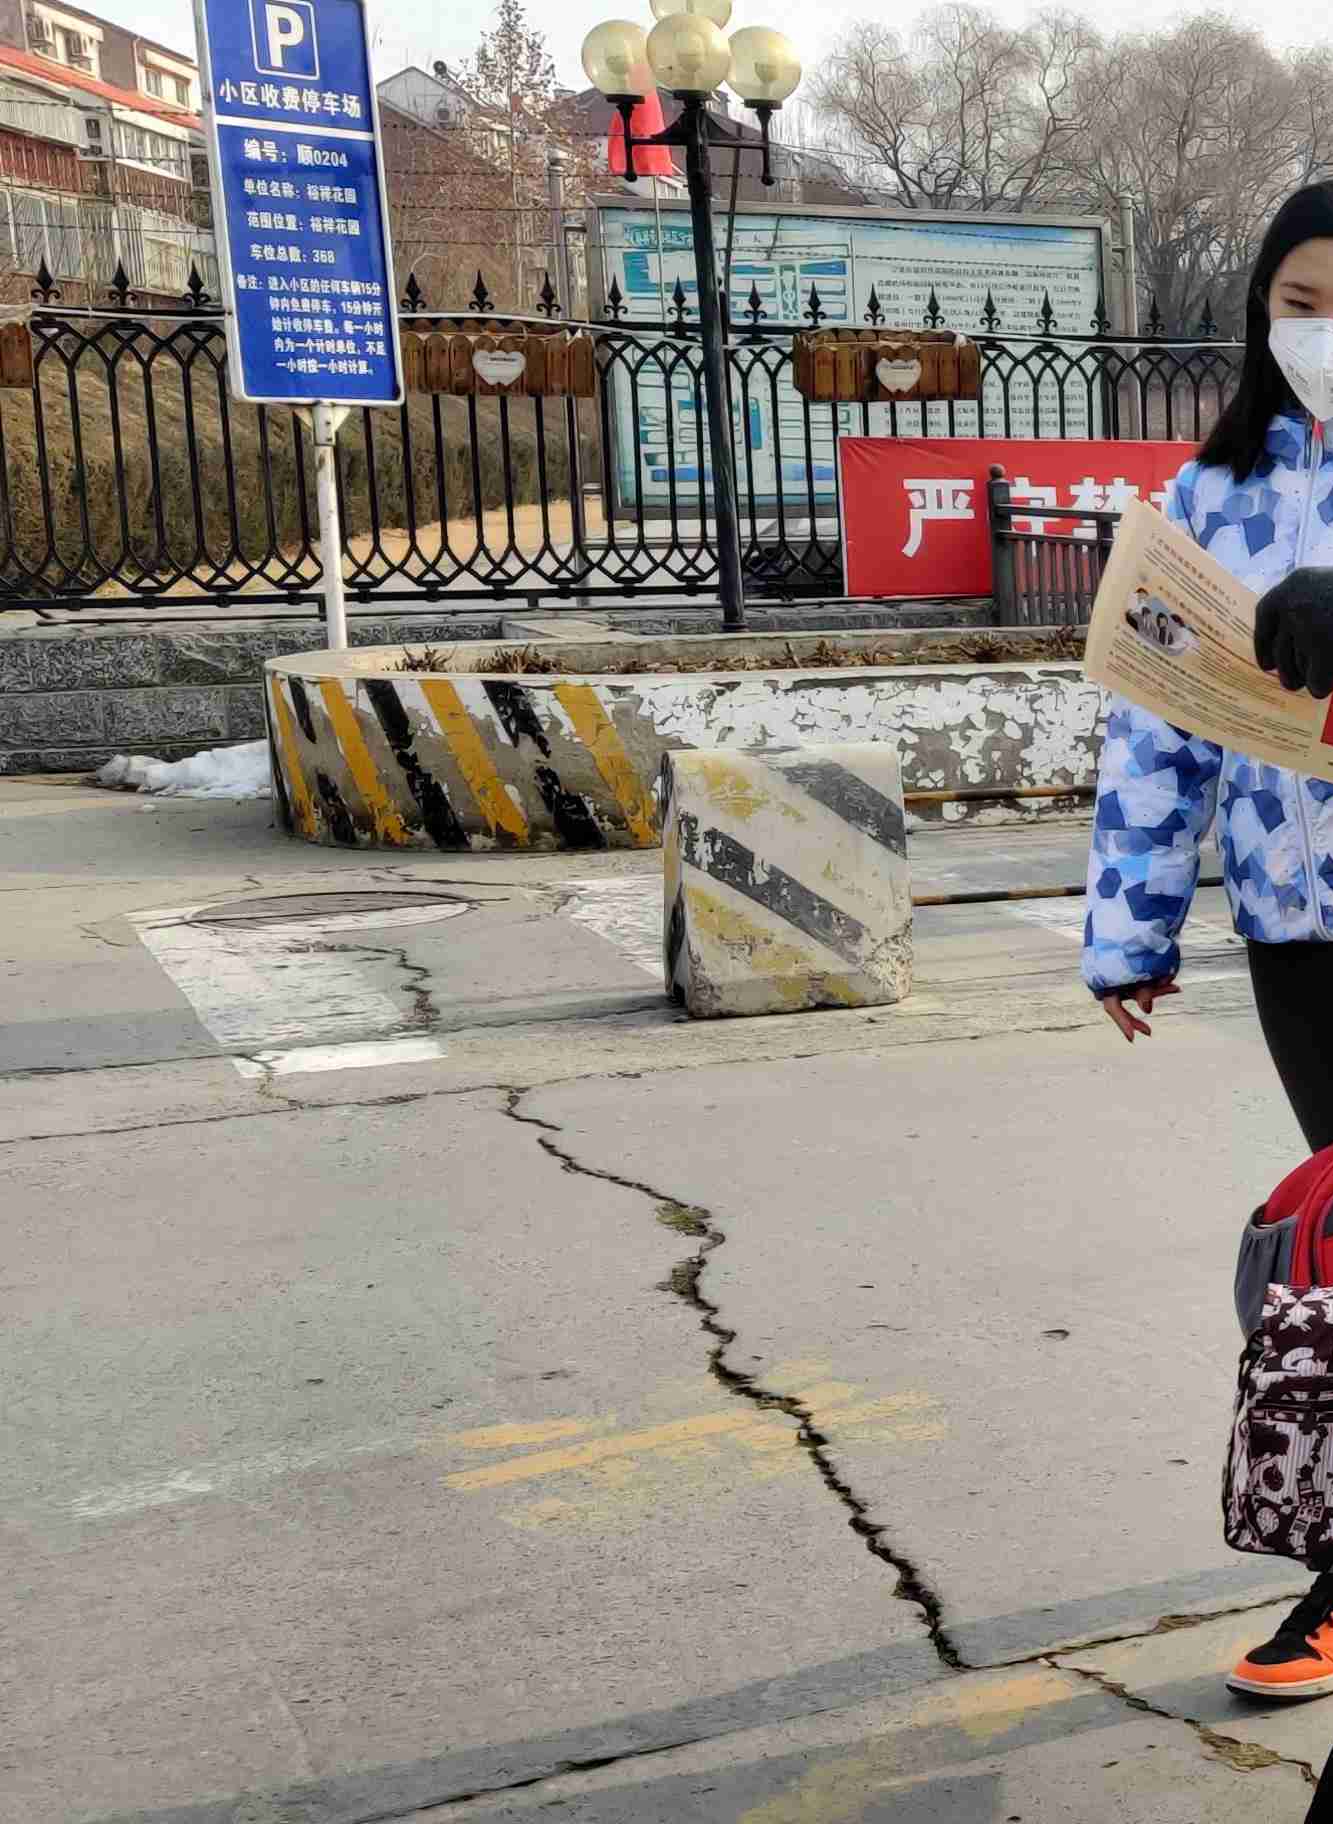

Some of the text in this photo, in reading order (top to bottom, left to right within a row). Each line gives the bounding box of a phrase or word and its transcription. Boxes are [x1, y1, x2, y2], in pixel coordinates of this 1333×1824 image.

[265, 3, 304, 68] P
[219, 78, 361, 118] 小区收费停车场
